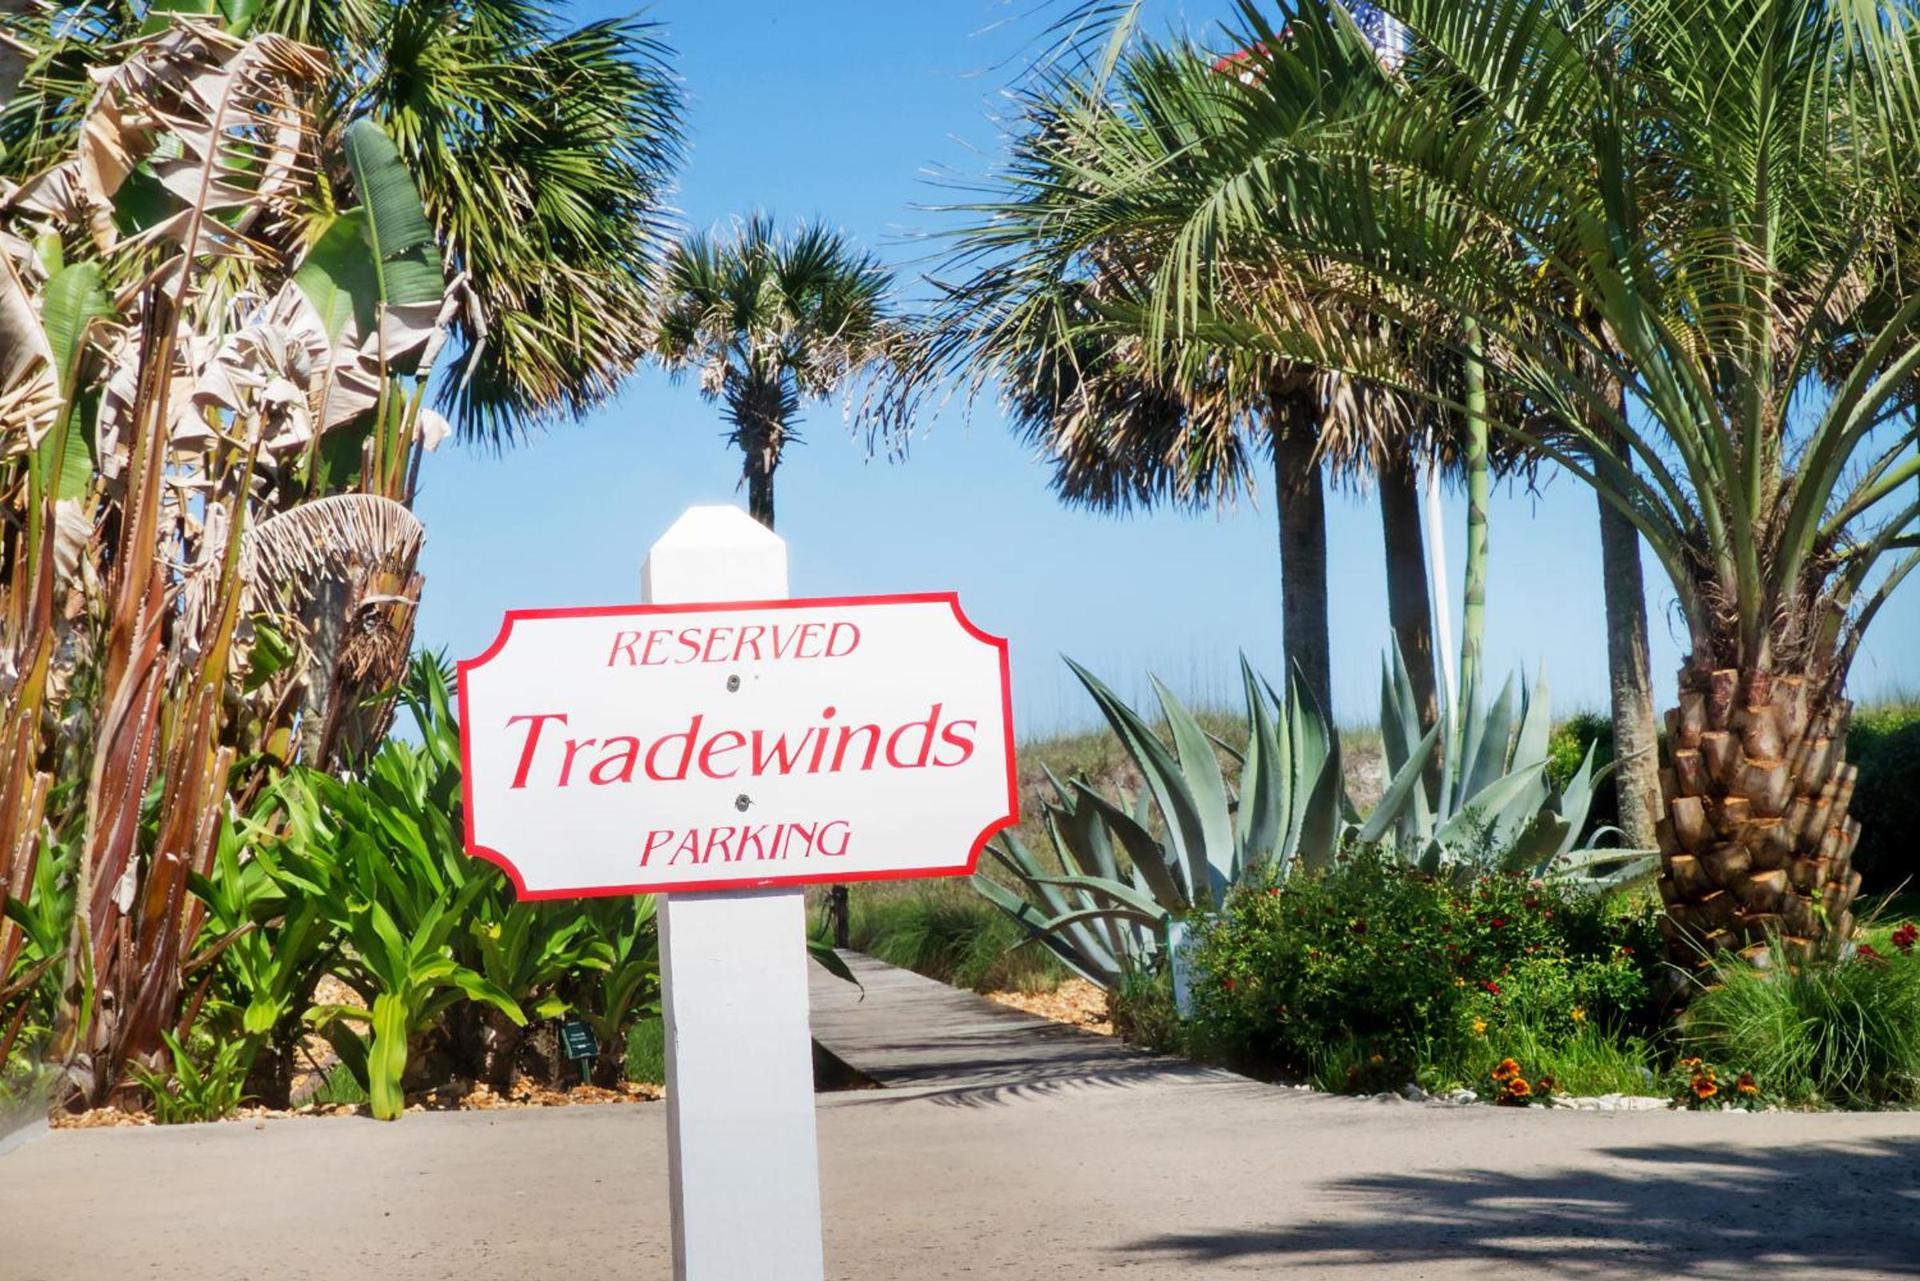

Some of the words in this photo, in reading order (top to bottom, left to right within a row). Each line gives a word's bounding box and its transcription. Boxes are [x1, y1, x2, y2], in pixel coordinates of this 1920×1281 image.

[607, 622, 861, 667] RESERVED
[505, 703, 977, 789] Tradewinds
[639, 821, 852, 867] PARKING
